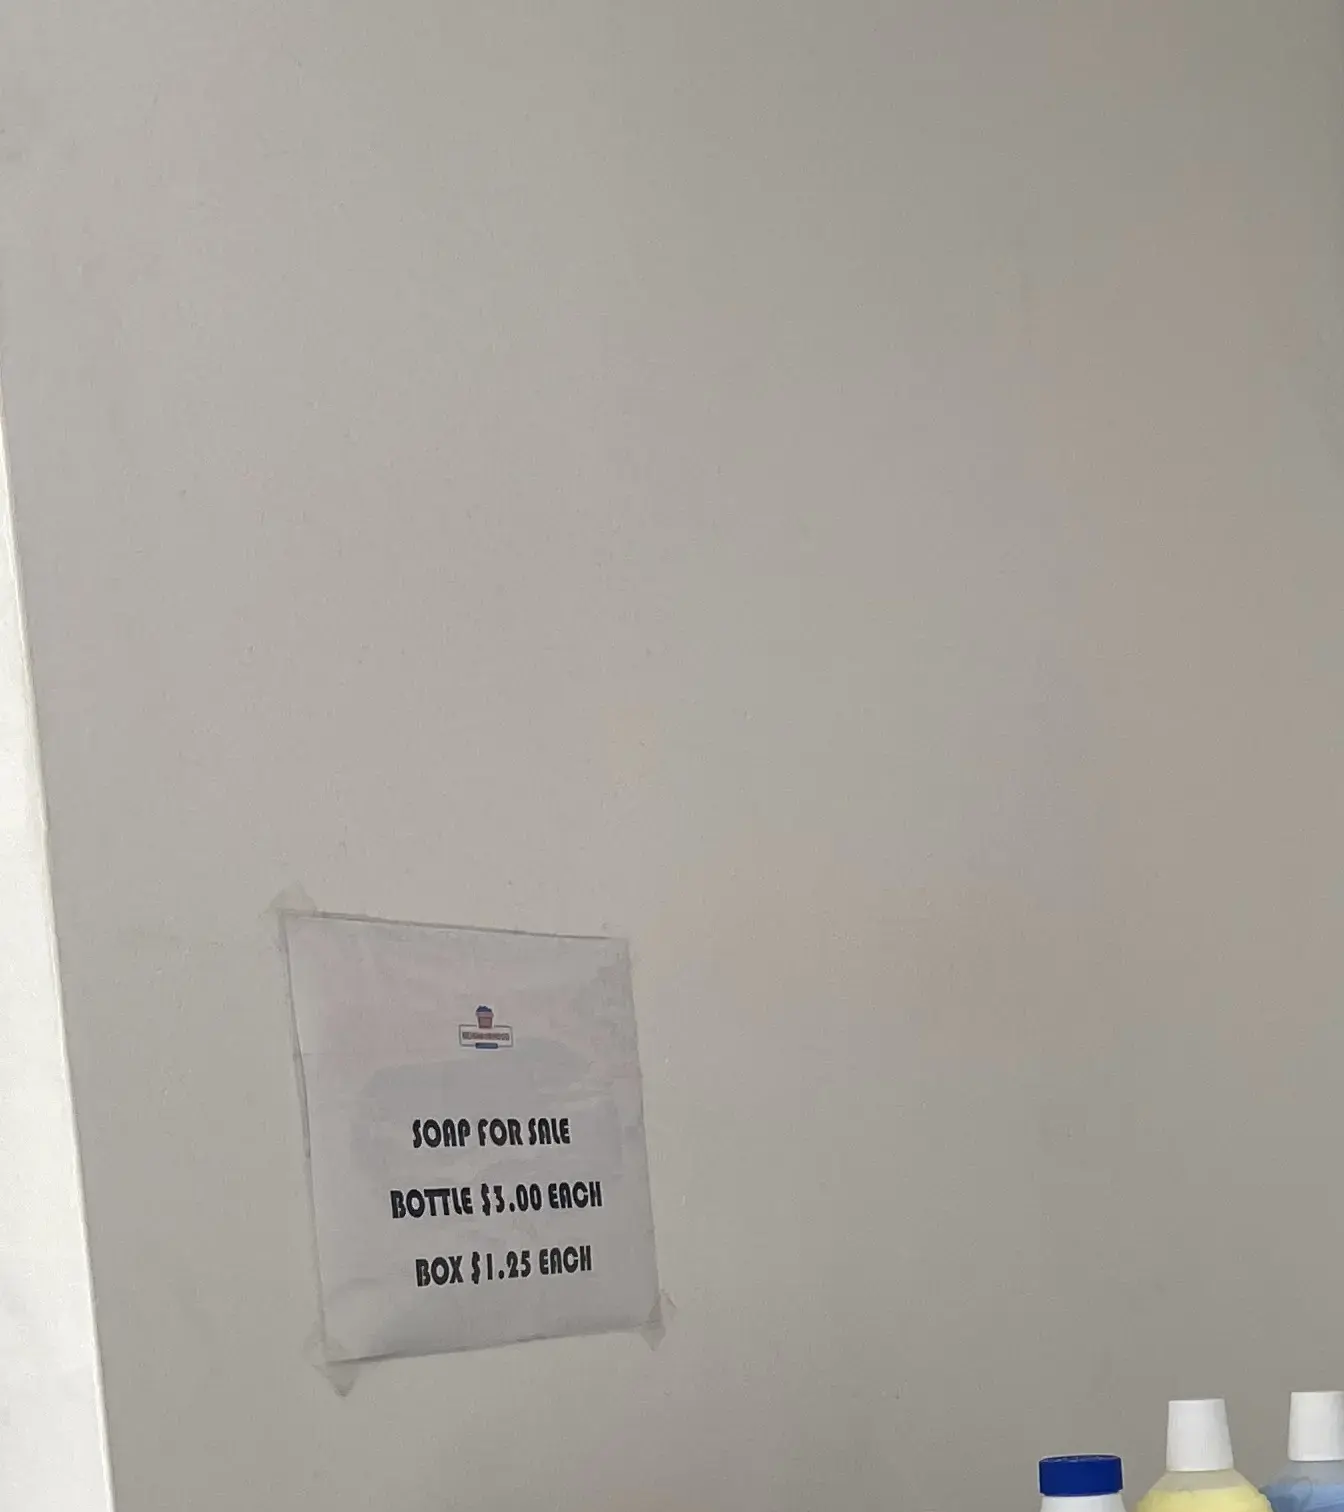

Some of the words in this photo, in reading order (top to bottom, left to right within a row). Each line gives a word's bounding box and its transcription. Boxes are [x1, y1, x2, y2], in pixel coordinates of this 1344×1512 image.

[413, 1119, 470, 1148] SOAP
[478, 1119, 523, 1147] FOR
[529, 1118, 571, 1145] SALE
[391, 1188, 472, 1218] BOTTLE
[548, 1181, 602, 1210] EACH
[416, 1256, 462, 1286] BOX
[471, 1251, 531, 1284] $1.25
[539, 1245, 592, 1275] EACH
